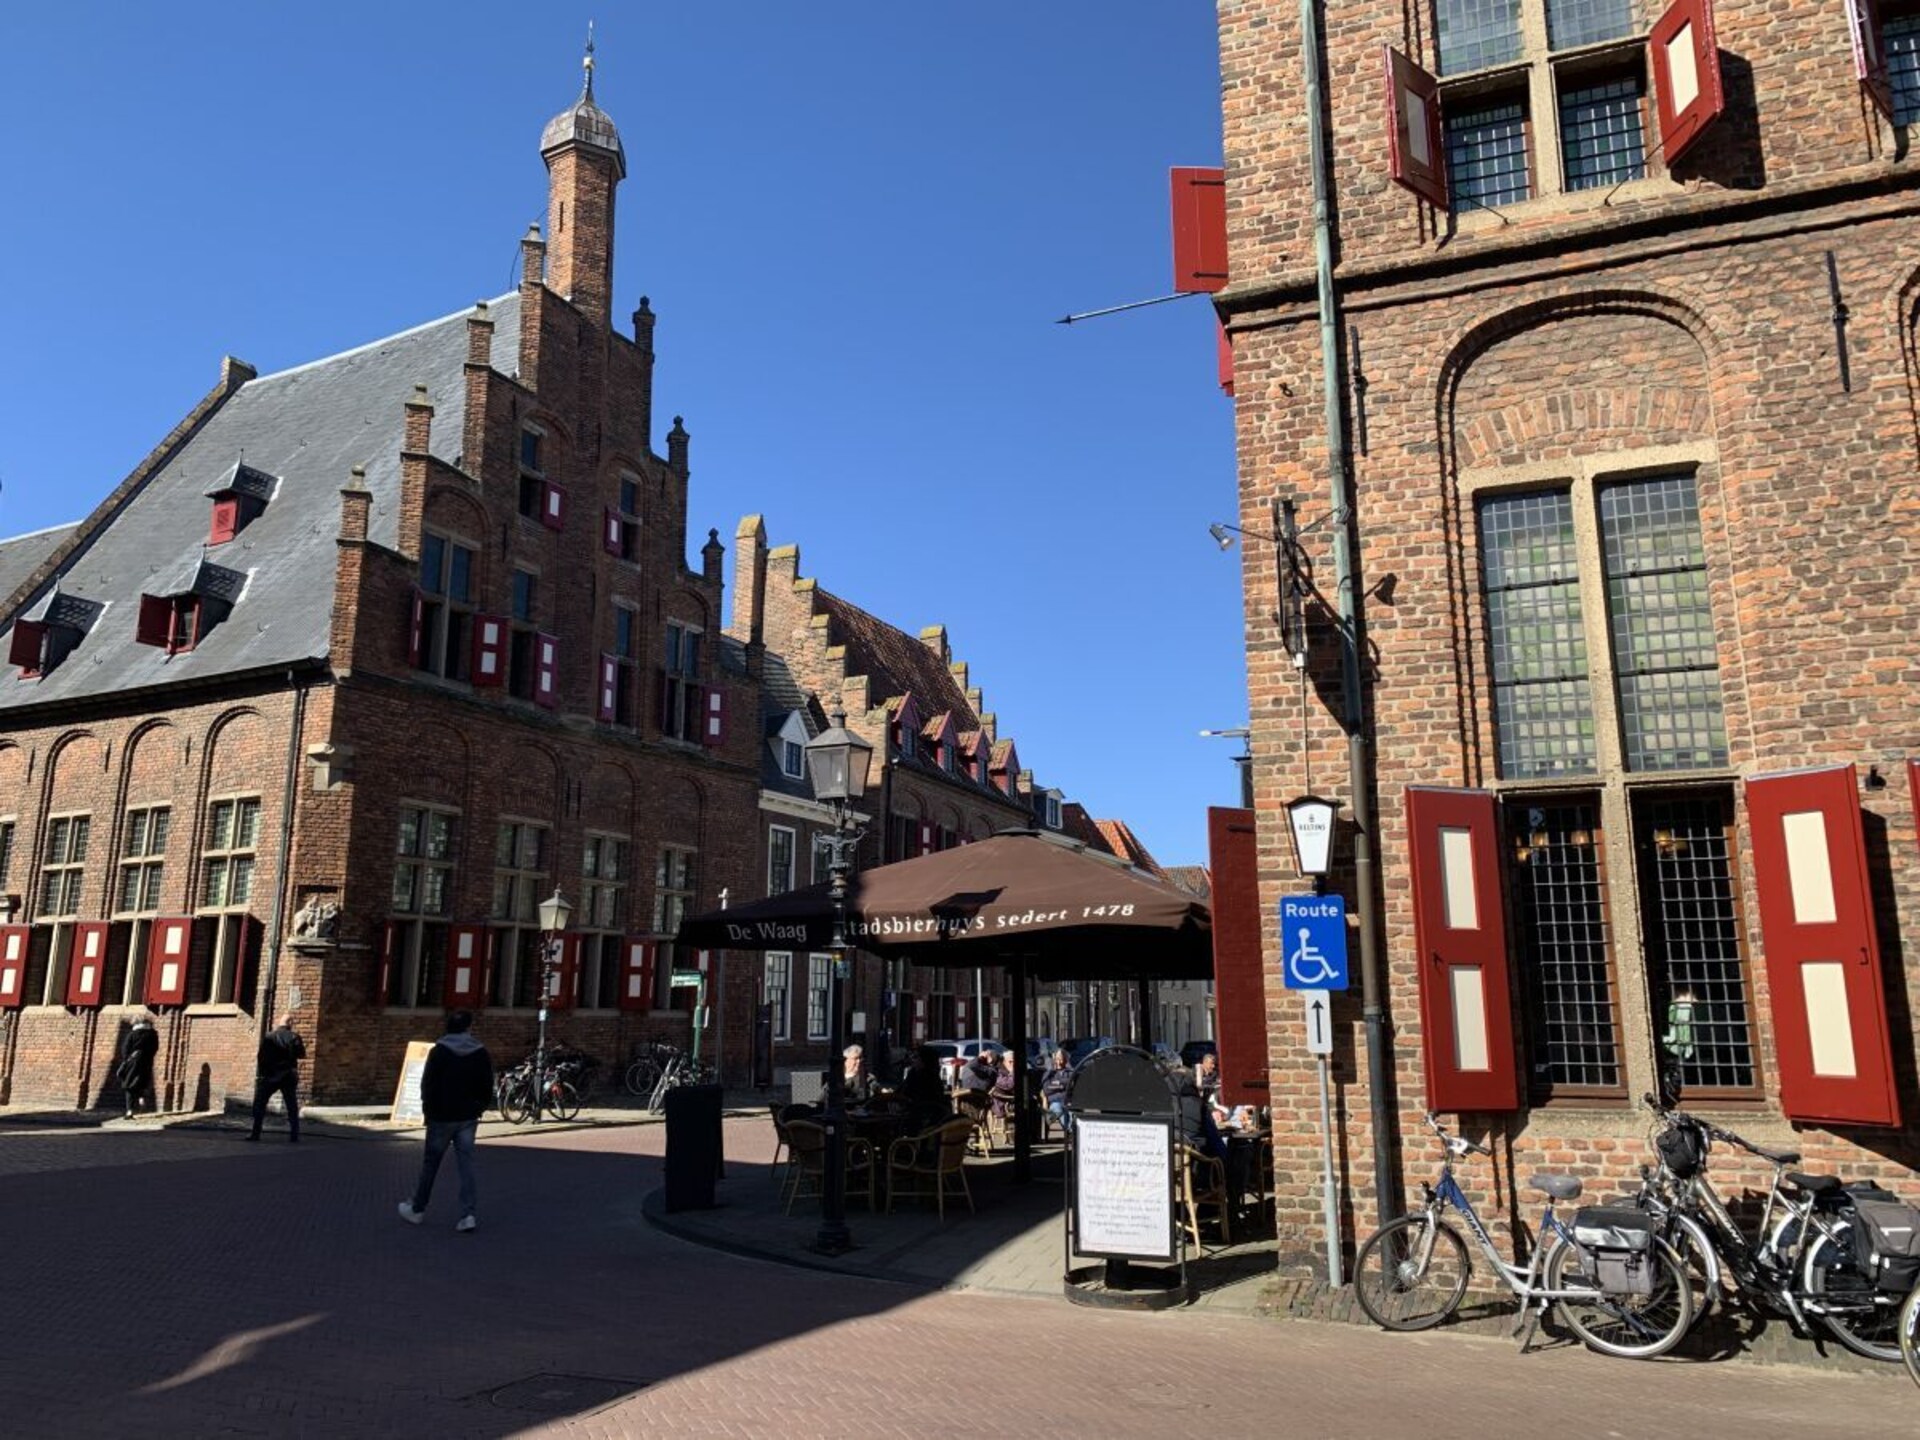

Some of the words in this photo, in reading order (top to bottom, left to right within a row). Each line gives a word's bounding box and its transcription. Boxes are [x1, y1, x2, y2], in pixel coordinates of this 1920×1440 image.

[727, 924, 752, 940] De
[756, 922, 807, 941] Waag
[844, 915, 986, 936] tadsbierhuys
[997, 909, 1068, 928] sedert
[1082, 903, 1136, 918] 1478
[1285, 903, 1339, 918] Route
[1462, 1209, 1489, 1246] GIANT
